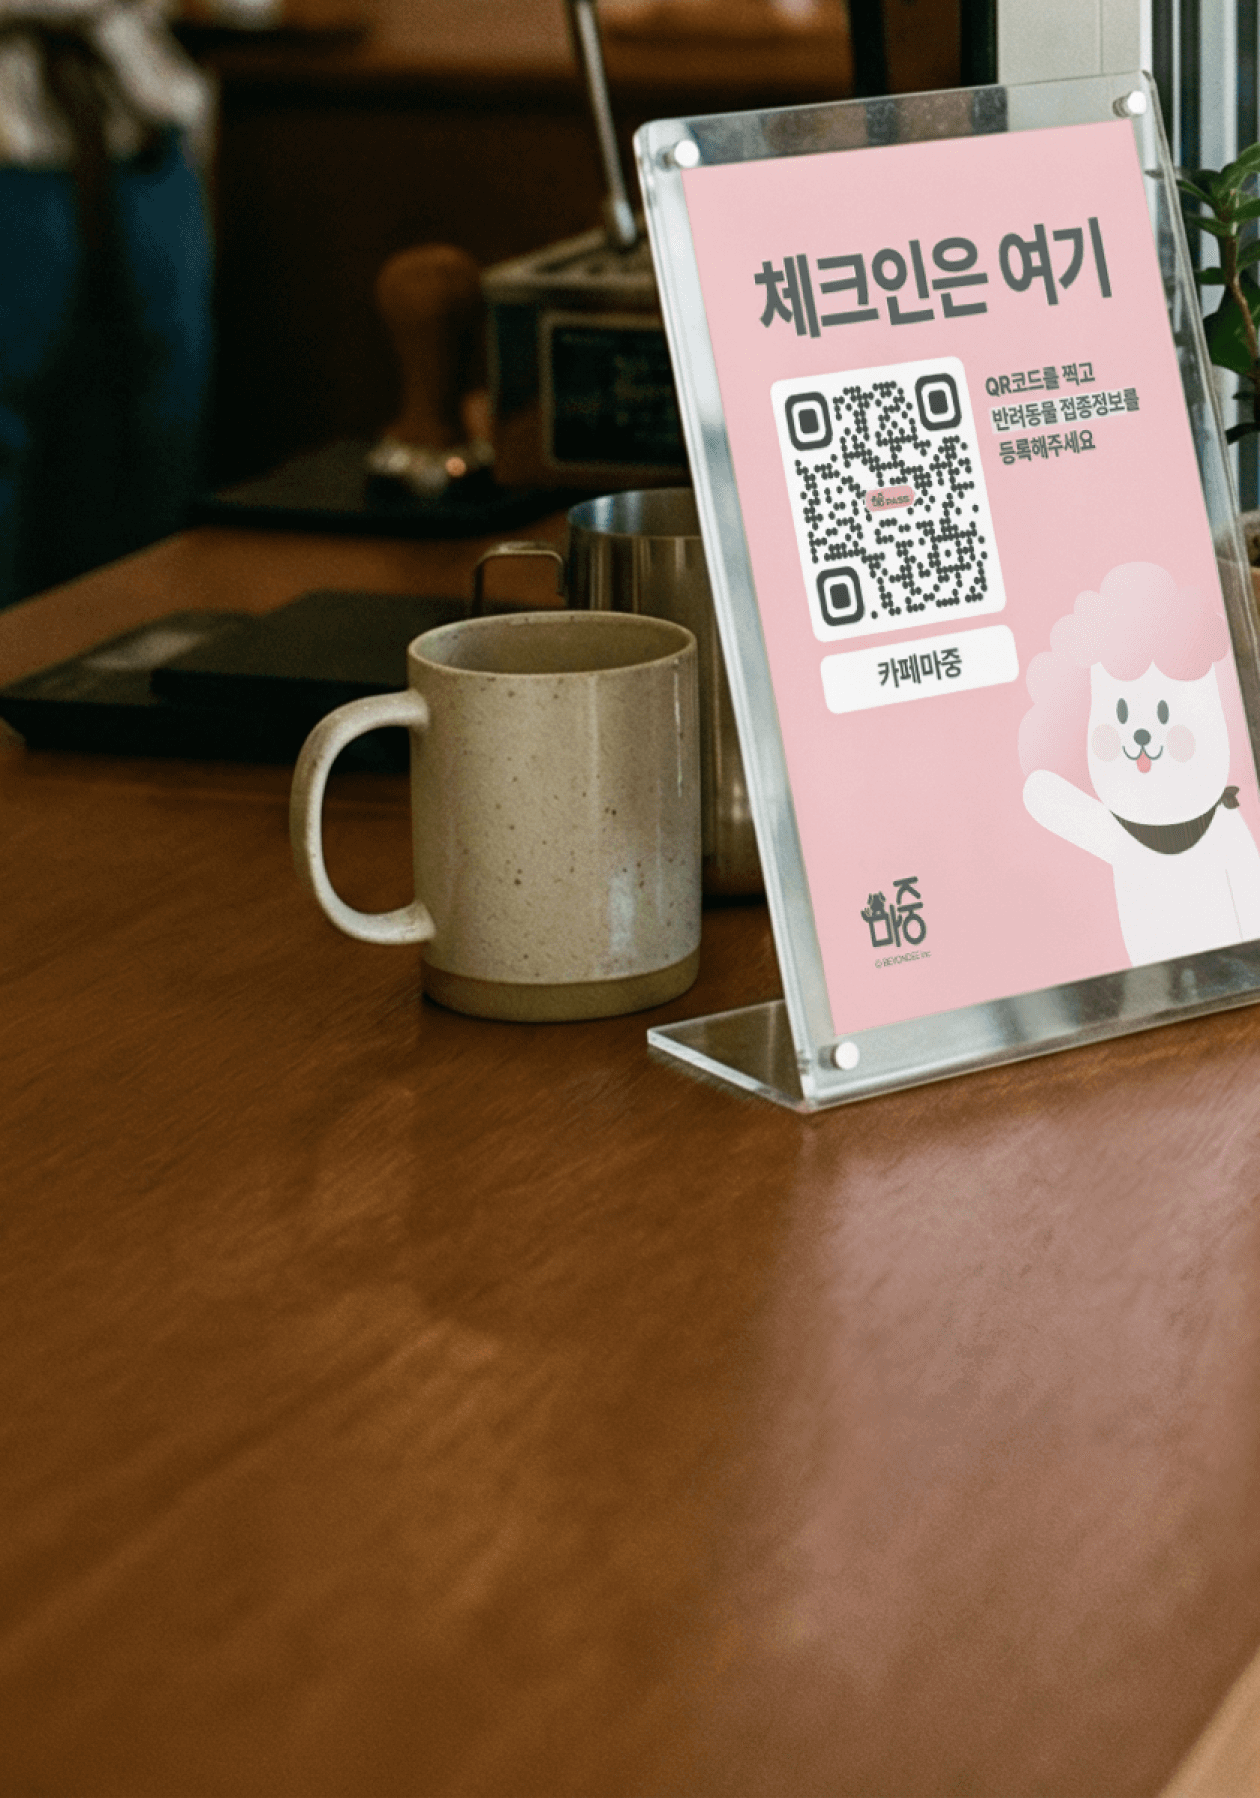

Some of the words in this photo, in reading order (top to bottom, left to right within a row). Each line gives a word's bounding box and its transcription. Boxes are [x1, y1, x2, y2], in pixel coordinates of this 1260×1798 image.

[754, 236, 989, 338] 체크인은
[998, 216, 1113, 306] 여기
[985, 365, 1060, 397] QR코드를
[1061, 362, 1096, 386] 찍고
[992, 400, 1058, 433] 반려동물
[1059, 387, 1140, 422] 접종정보를
[999, 430, 1096, 465] 등록해주세요
[877, 648, 962, 688] 카페마중
